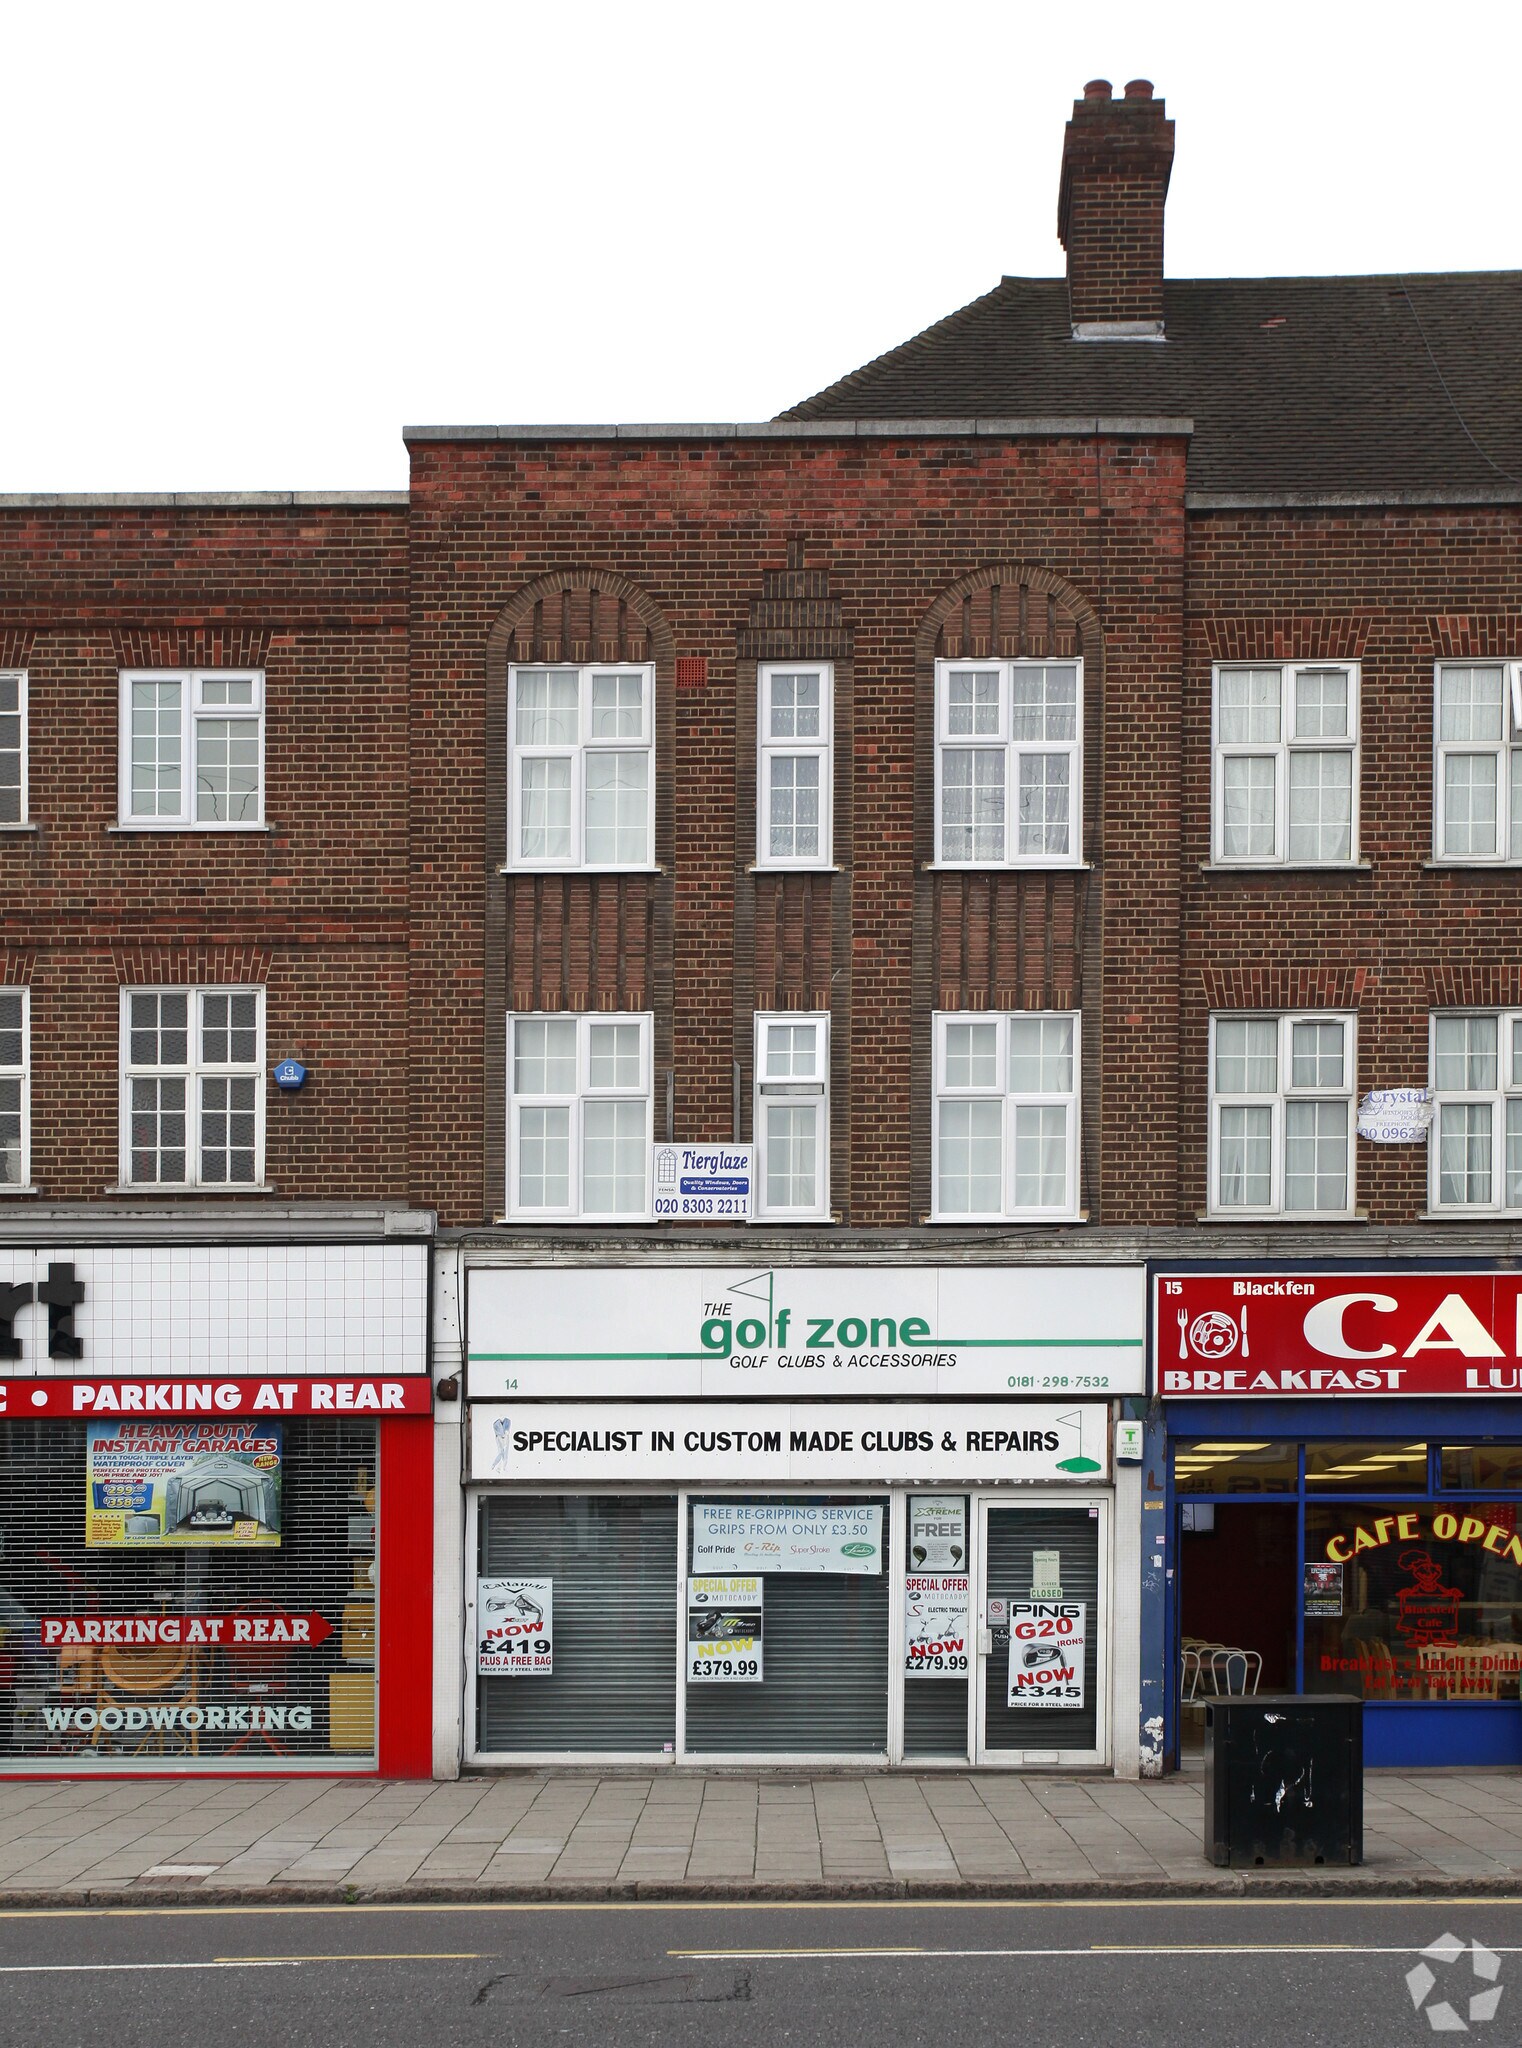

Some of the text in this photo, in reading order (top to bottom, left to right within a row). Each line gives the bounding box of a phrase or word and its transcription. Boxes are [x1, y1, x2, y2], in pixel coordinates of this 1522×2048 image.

[1368, 1088, 1427, 1107] Crystal
[682, 1150, 748, 1175] Tierglaze
[655, 1199, 748, 1213] 020 8303 2211
[1165, 1281, 1315, 1296] 15 Blackfen
[704, 1303, 733, 1316] THE
[700, 1290, 931, 1359] golf zone
[1303, 1293, 1522, 1360] CA
[730, 1353, 957, 1369] GOLF CLUBS & ACCESSORIES
[505, 1378, 518, 1390] 14
[1164, 1368, 1522, 1391] BREAKFAST LU
[72, 1383, 406, 1411] PARKING AT REAR
[118, 1424, 258, 1439] HEAVY DUTY
[92, 1438, 278, 1454] INSTANT GARAGES
[513, 1430, 1060, 1452] SPECIALIST IN CUSTOM MADE CLUBS & REPAIRS
[256, 1460, 278, 1468] RANGE
[703, 1508, 873, 1520] FREE RE-GRIPPING SERVICE
[914, 1507, 962, 1517] XTREME
[708, 1523, 868, 1536] GRIPS FROM ONLY £3.50
[914, 1522, 962, 1537] FREE
[1326, 1513, 1522, 1567] CAFE OPEN
[697, 1545, 735, 1554] Golf Pride
[482, 1582, 547, 1590] Callaway
[693, 1579, 757, 1593] SPECIAL OFFER
[906, 1578, 968, 1591] SPECIAL OFFER
[1031, 1589, 1062, 1598] CLOSED
[1012, 1604, 1080, 1618] PING
[1404, 1605, 1455, 1614] Blackfen
[486, 1621, 544, 1640] NOW
[1015, 1616, 1073, 1640] G20
[1417, 1618, 1443, 1628] Cafe
[45, 1619, 310, 1643] PARKING AT REAR
[479, 1639, 551, 1654] £419
[697, 1637, 754, 1659] NOW
[910, 1638, 964, 1658] NOW
[1057, 1637, 1084, 1647] IRONS
[480, 1656, 552, 1666] PLUS A FREE BAG
[692, 1660, 758, 1676] £379.99
[905, 1655, 968, 1670] £279.99
[1320, 1655, 1398, 1671] Breakfast
[1416, 1655, 1465, 1671] Lunch
[1017, 1666, 1075, 1687] NOW
[1365, 1675, 1386, 1689] Eat
[1407, 1677, 1421, 1689] or
[1427, 1676, 1456, 1689] Take
[1459, 1676, 1492, 1691] Away
[1011, 1686, 1081, 1698] £345
[42, 1706, 312, 1731] WOODWORKING
